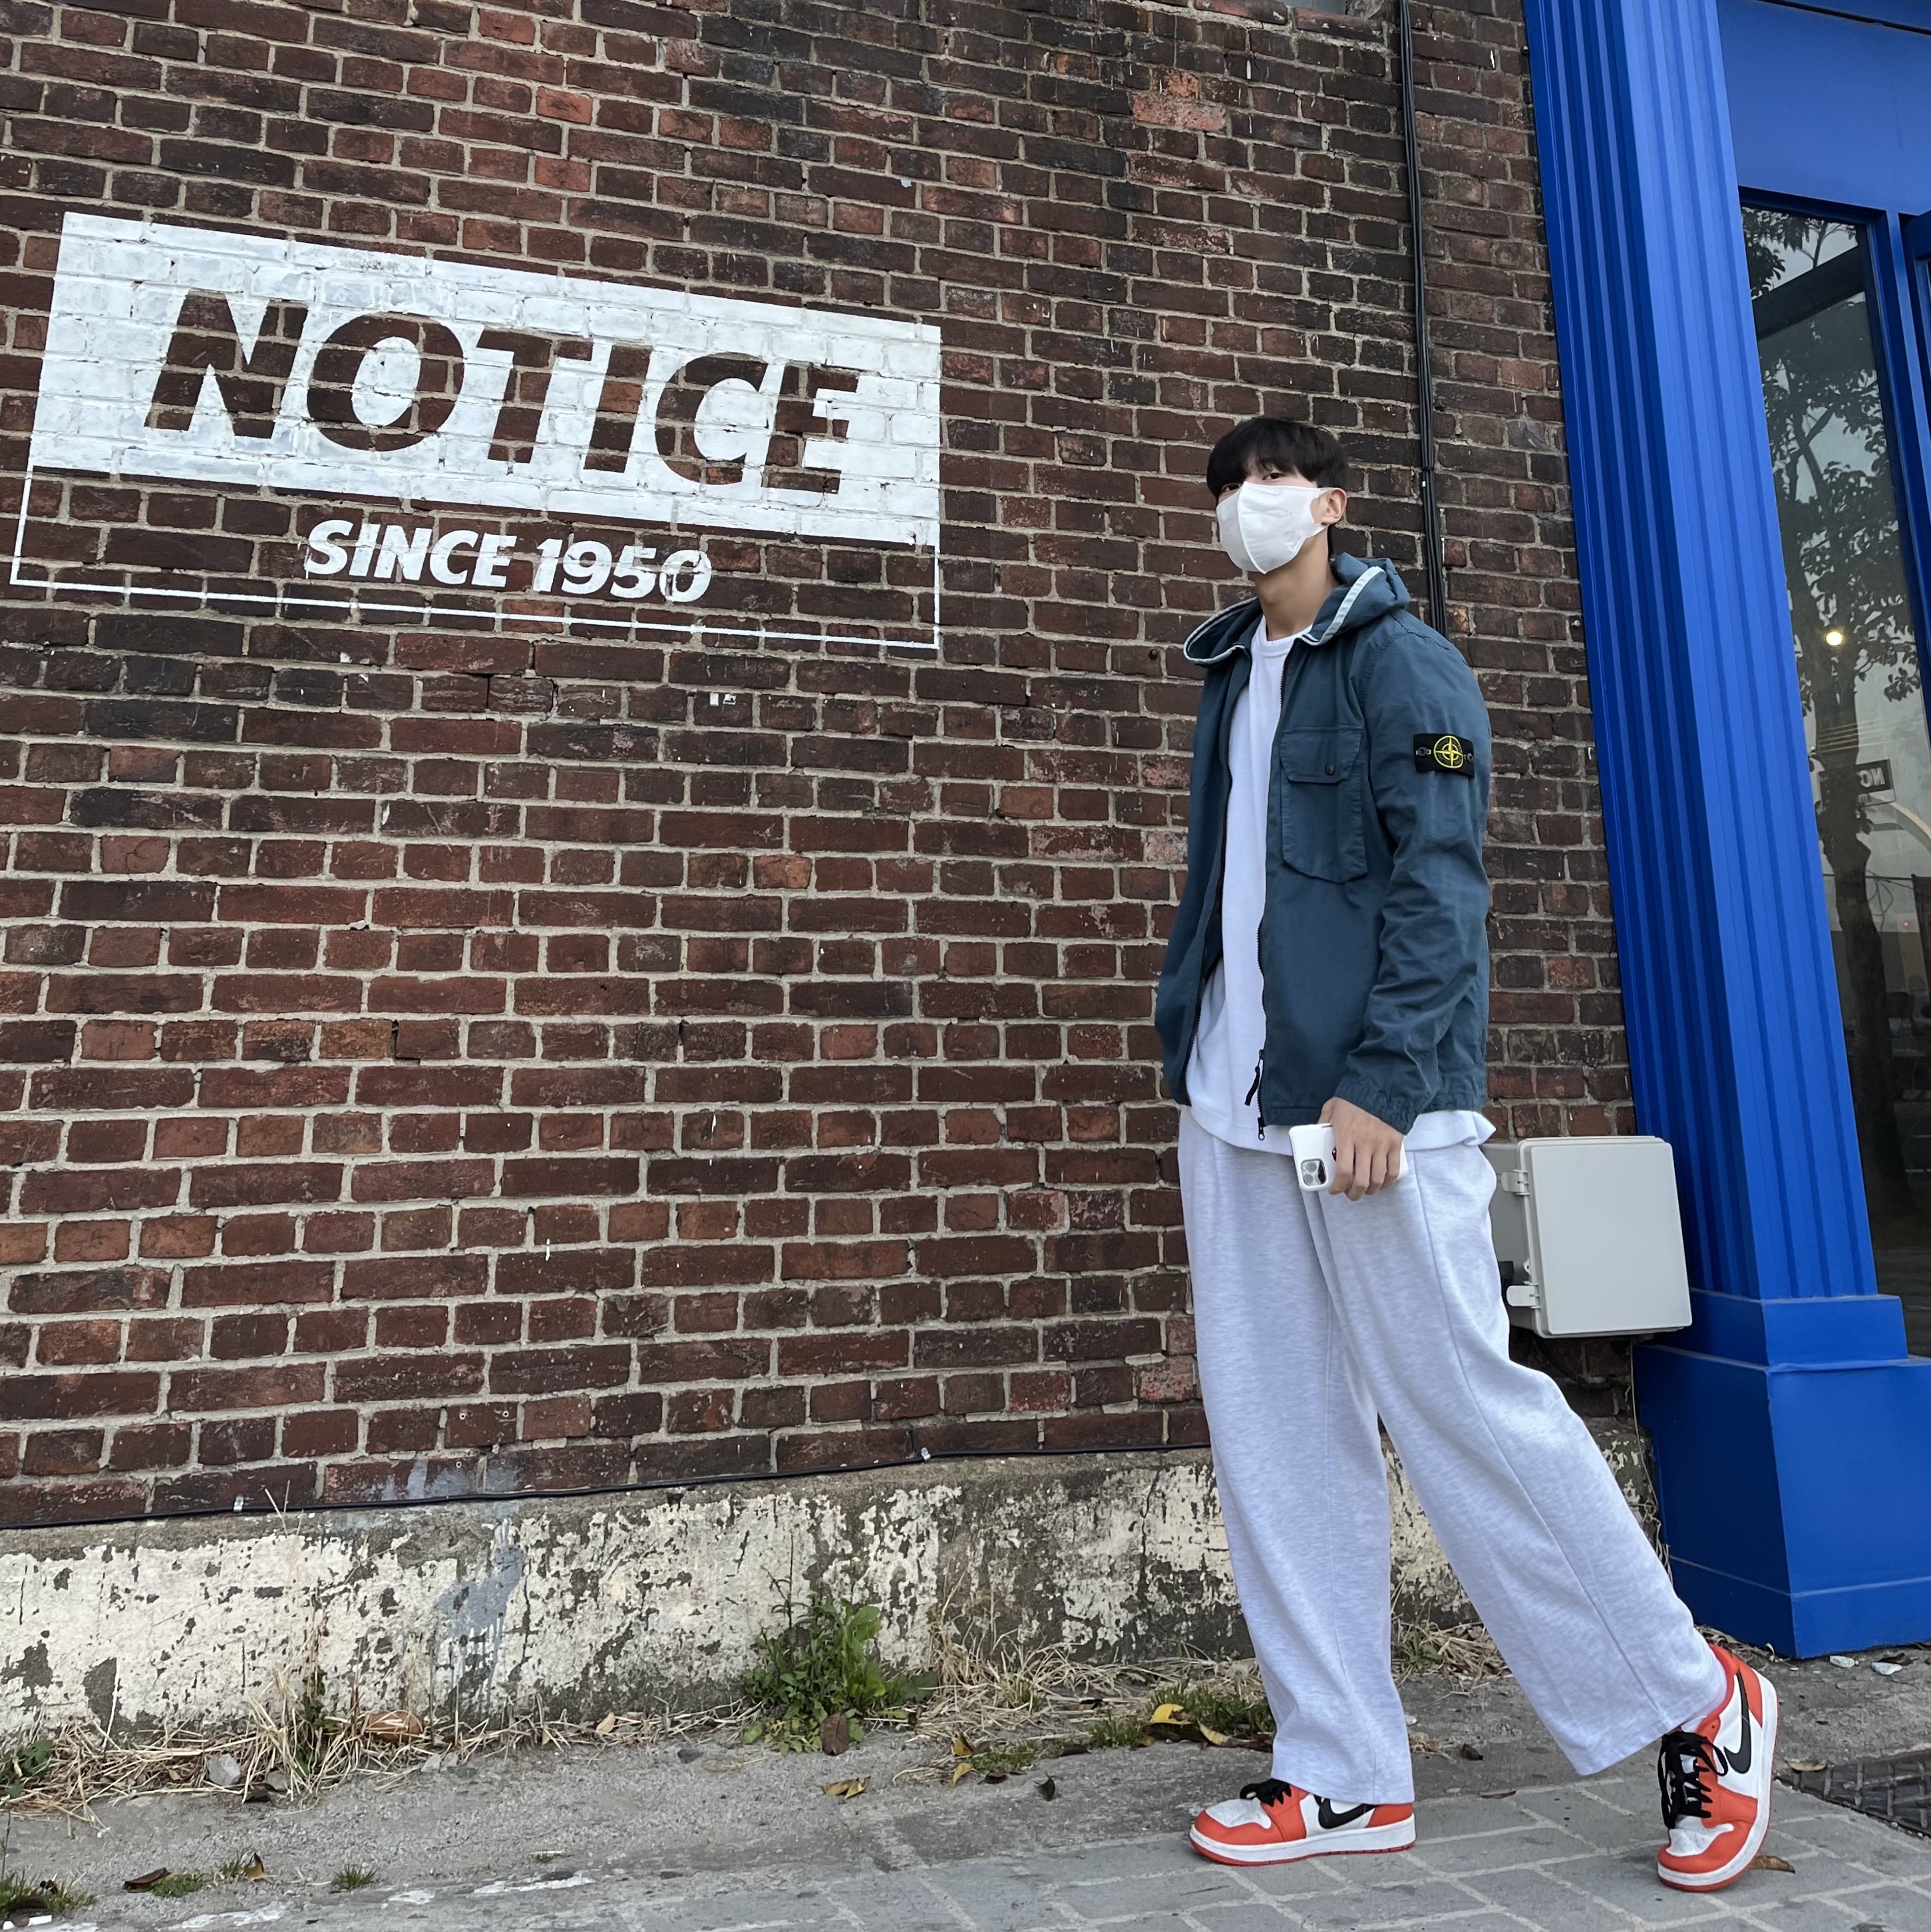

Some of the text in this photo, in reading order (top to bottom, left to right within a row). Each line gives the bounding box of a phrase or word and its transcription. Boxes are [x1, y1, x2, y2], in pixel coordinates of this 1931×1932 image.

[144, 288, 858, 494] NOTICE
[304, 519, 713, 603] SINCE 1950
